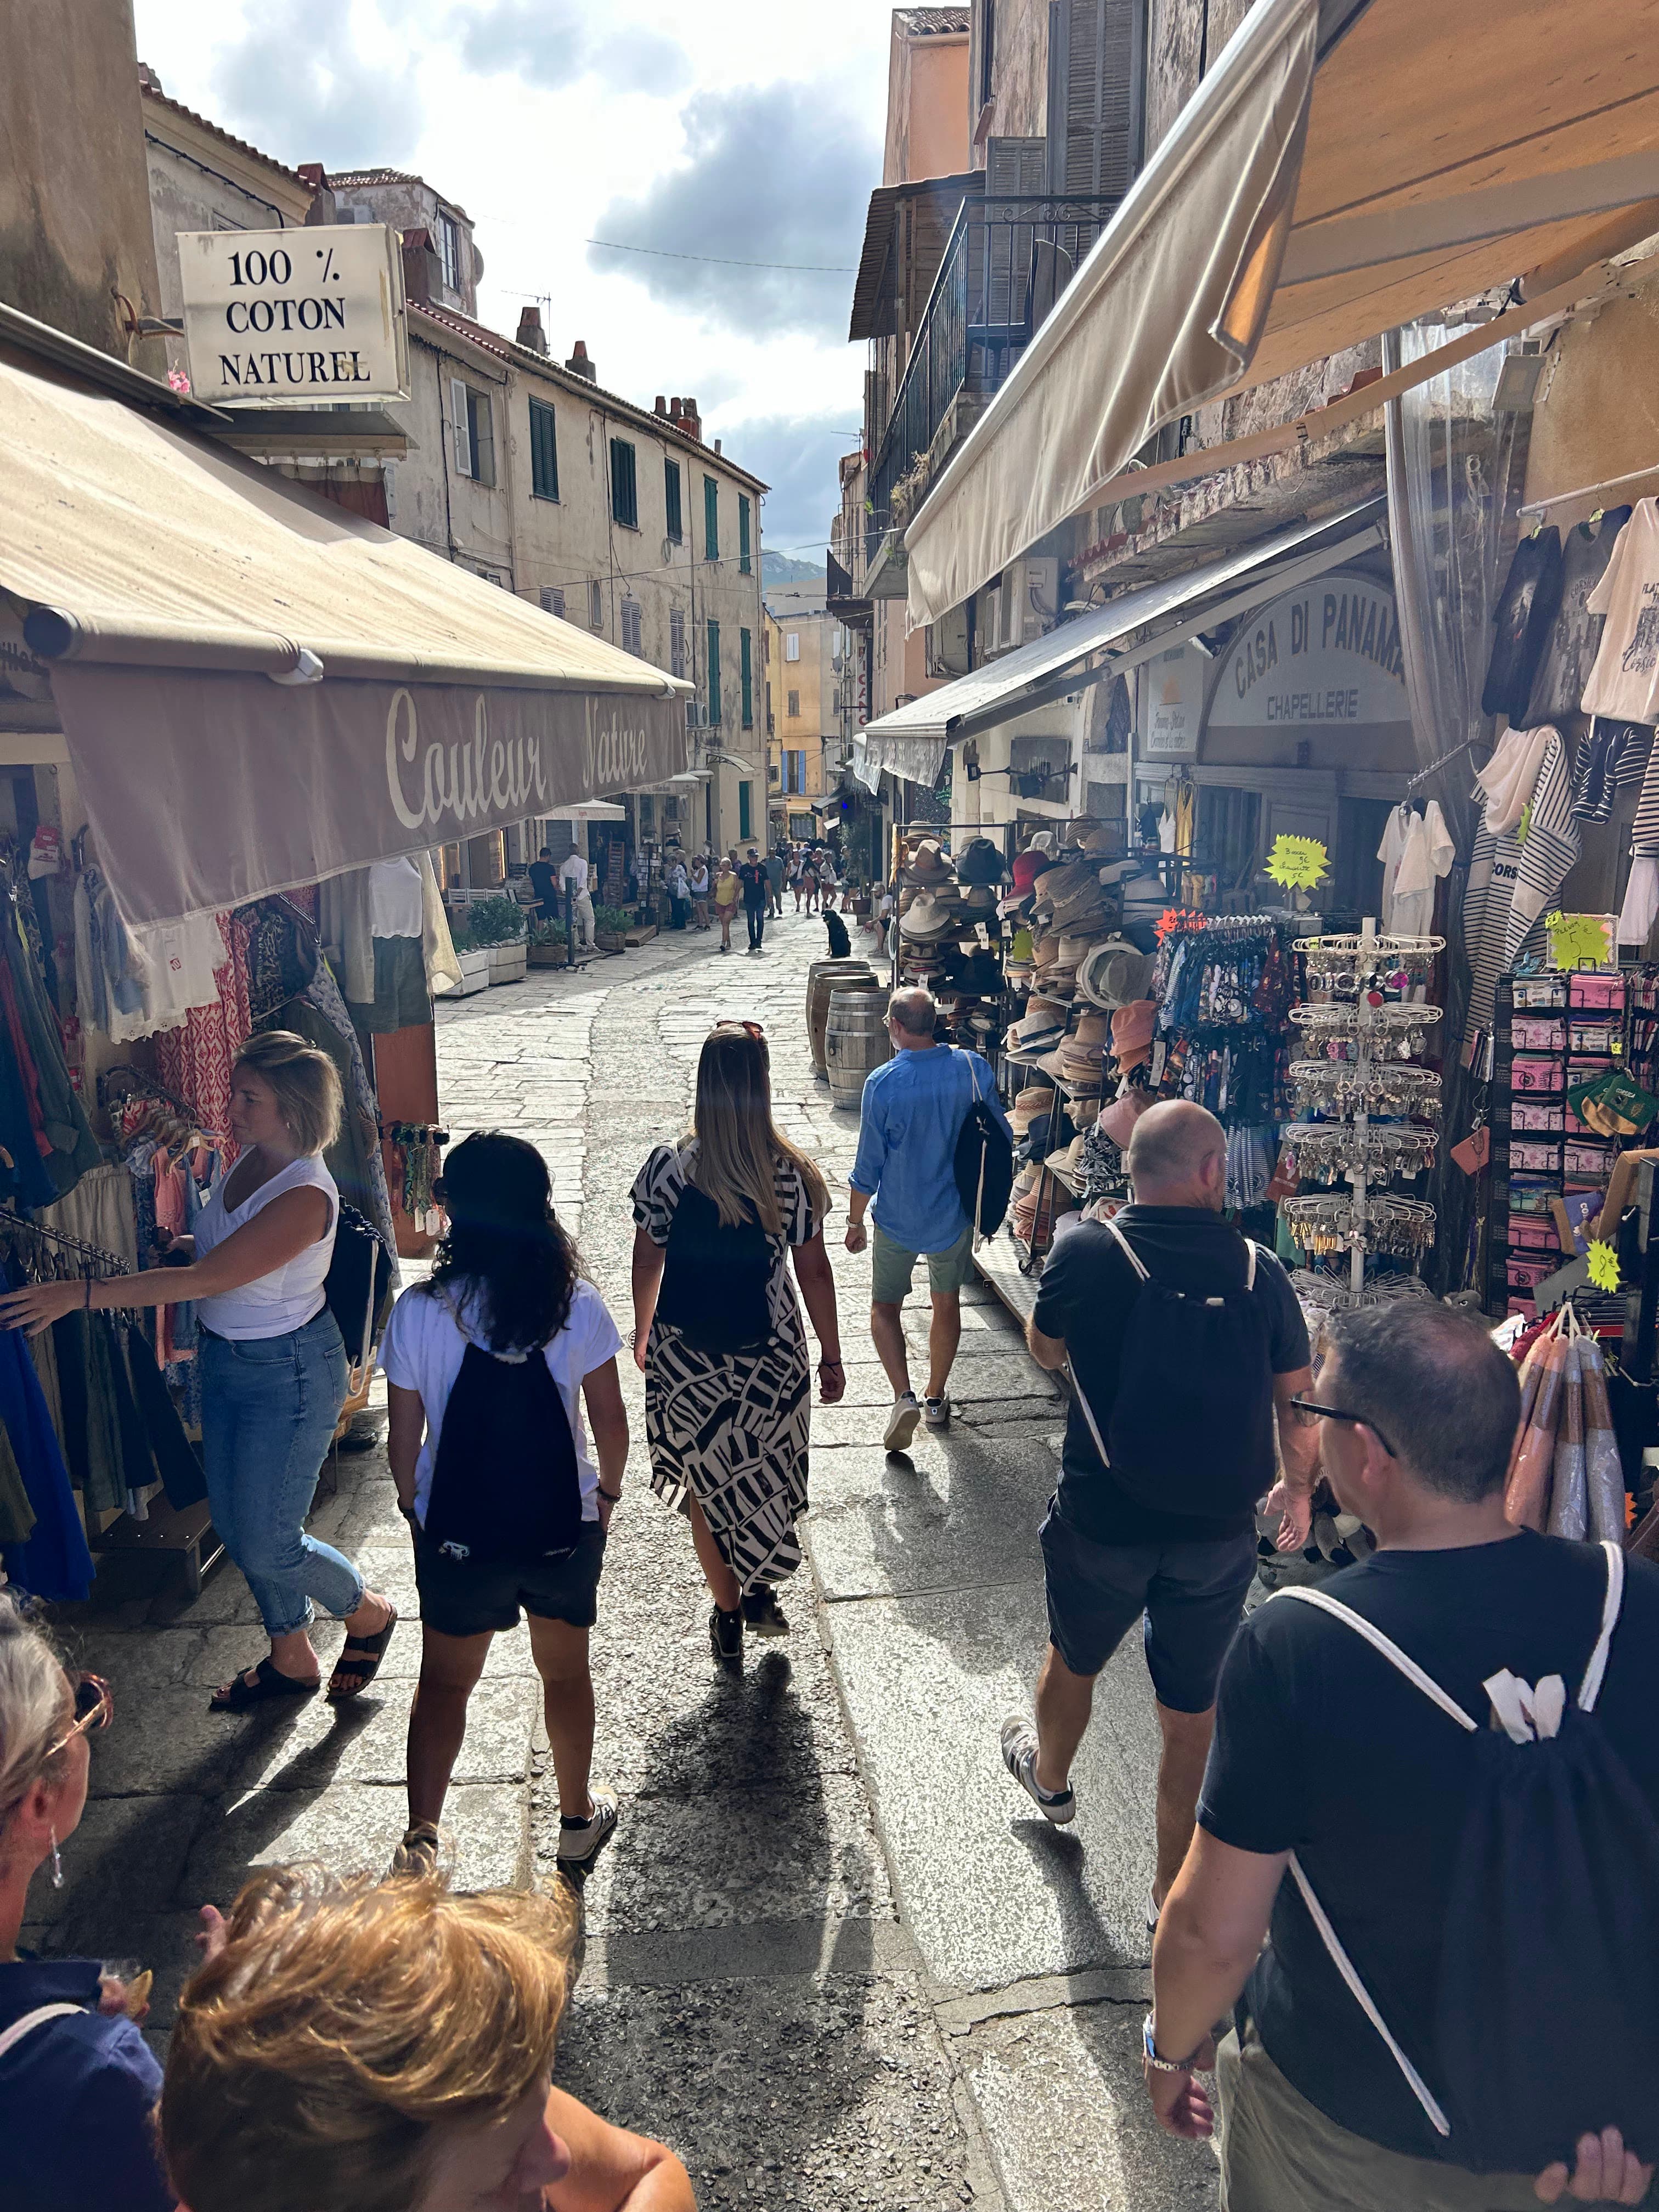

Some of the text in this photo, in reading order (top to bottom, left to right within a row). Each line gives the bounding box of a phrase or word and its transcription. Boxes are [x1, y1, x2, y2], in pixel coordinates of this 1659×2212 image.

[228, 248, 340, 286] 100 %
[225, 297, 346, 333] COTON
[218, 351, 371, 385] NATUREL
[1235, 620, 1279, 699] CASA
[1291, 600, 1310, 656] DI
[1267, 689, 1359, 721] CHAPELLERIE
[385, 687, 647, 830] Couleur Nature
